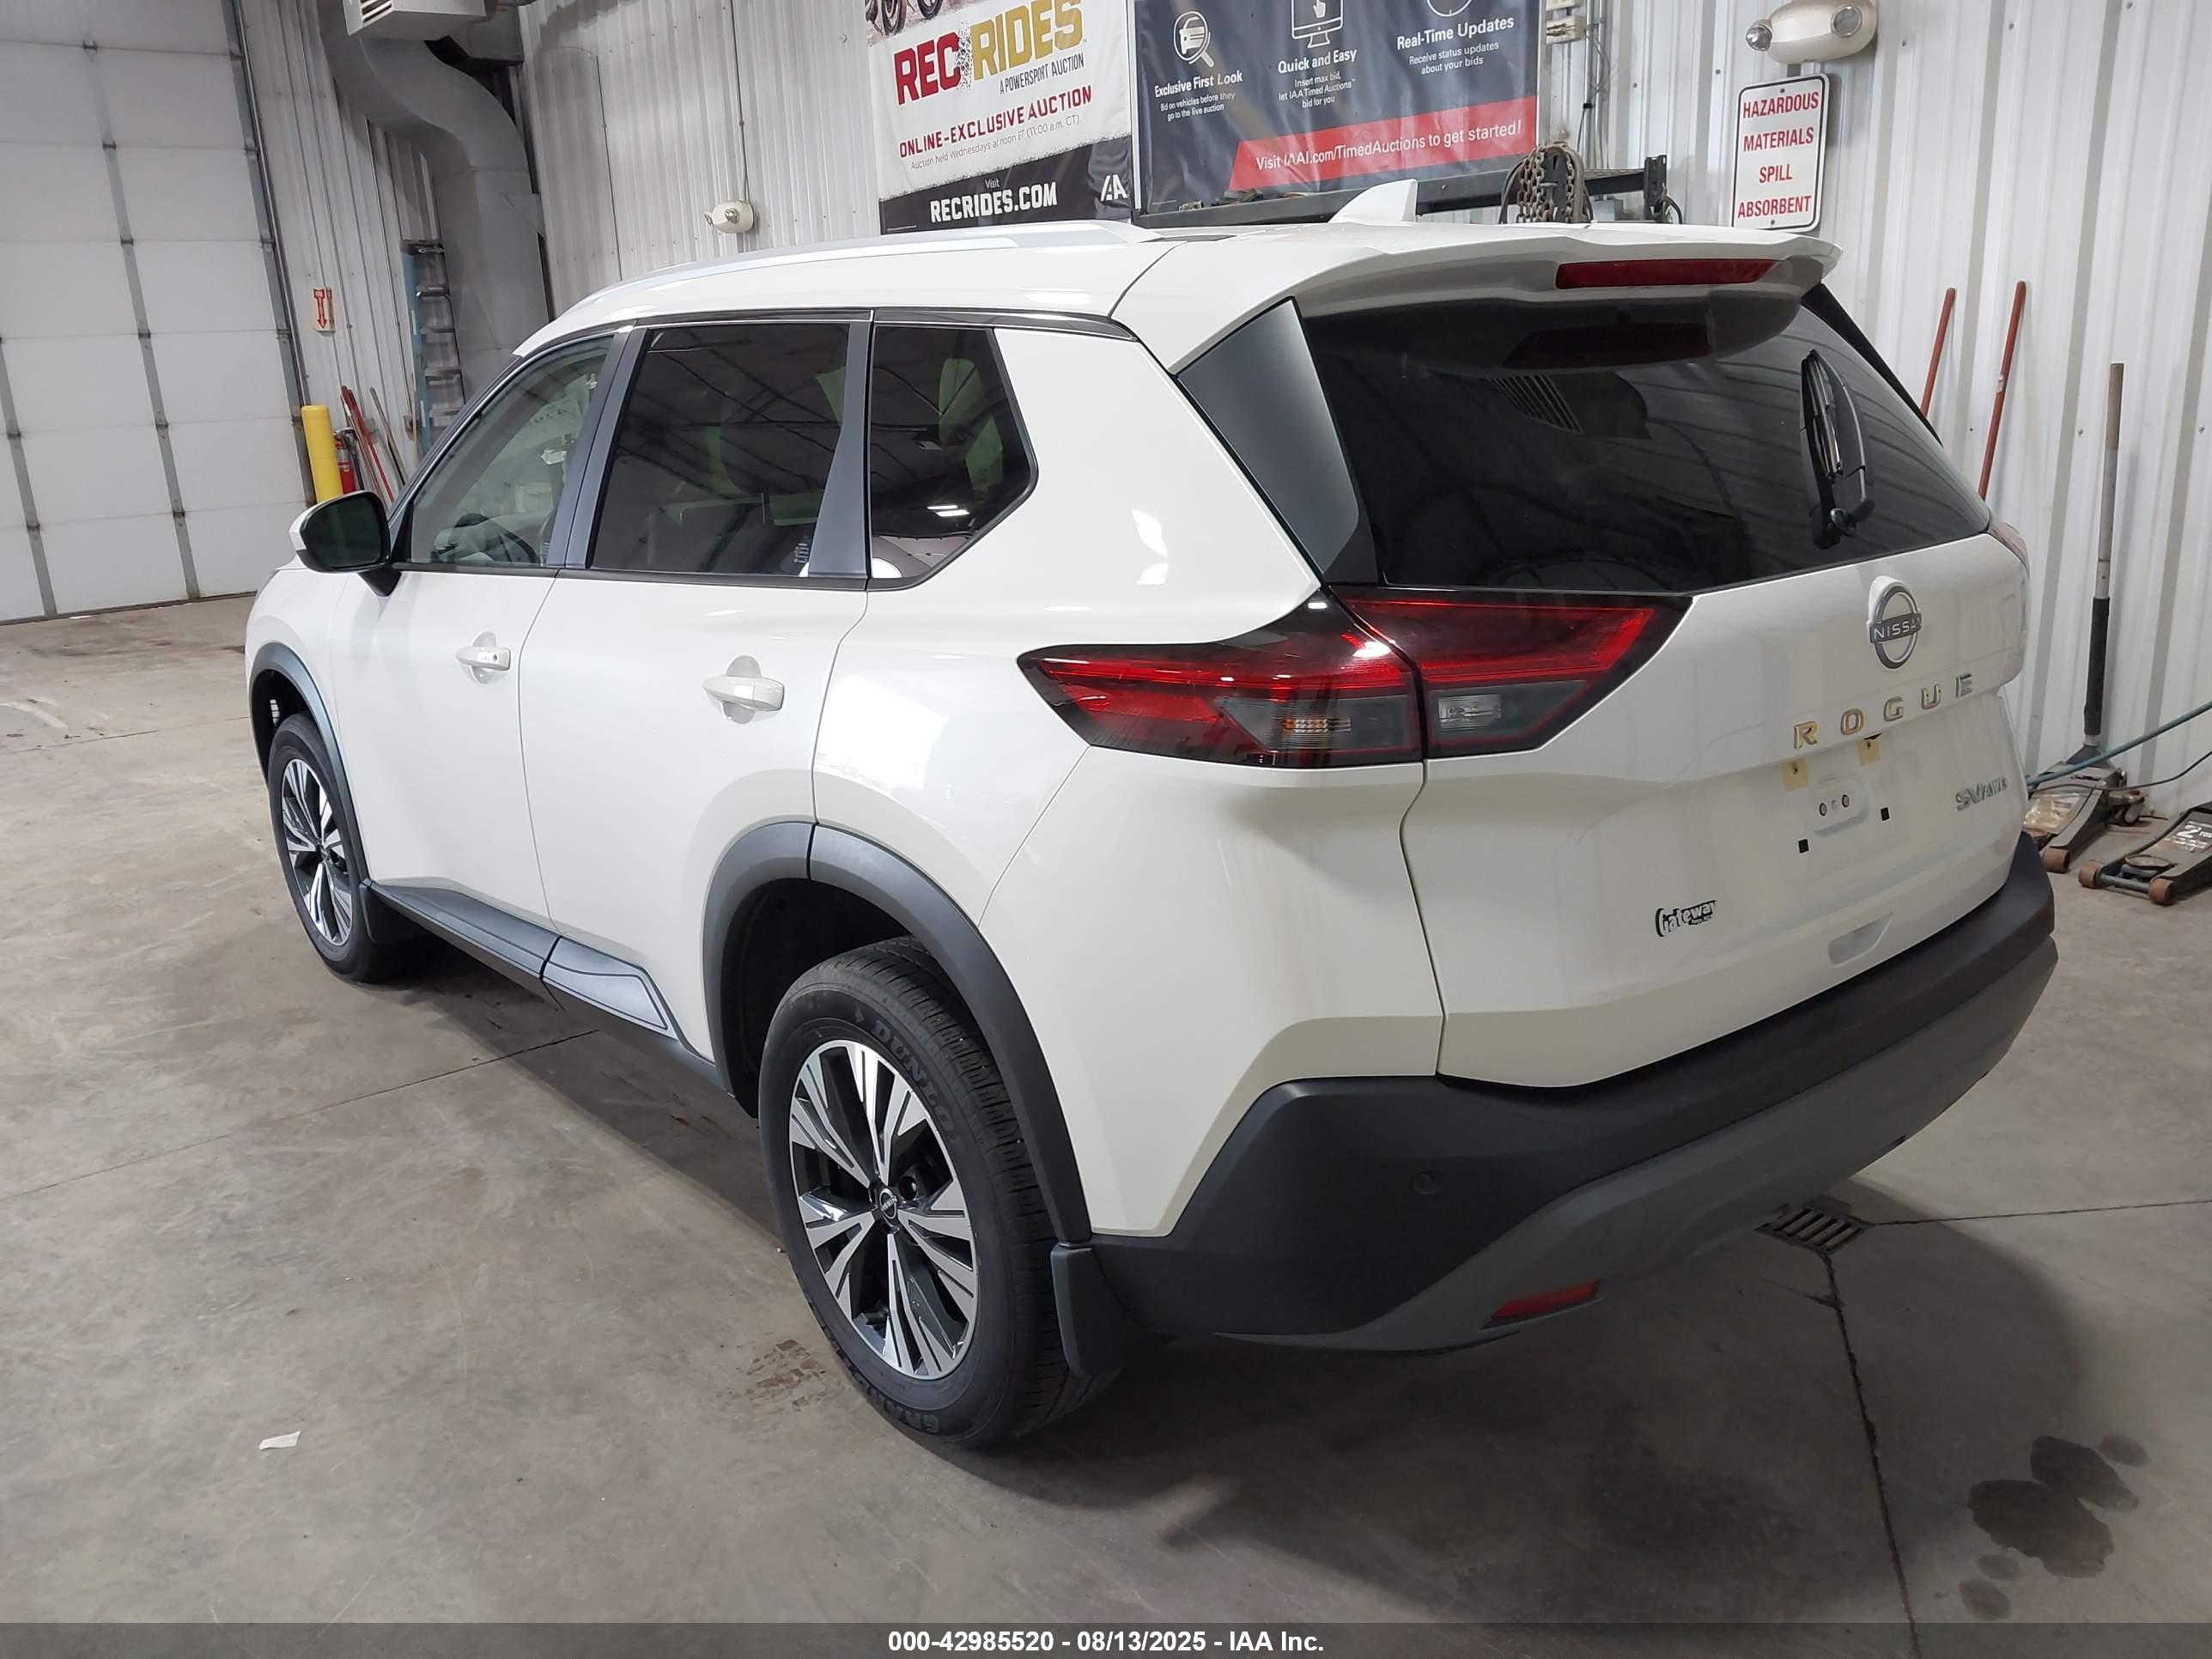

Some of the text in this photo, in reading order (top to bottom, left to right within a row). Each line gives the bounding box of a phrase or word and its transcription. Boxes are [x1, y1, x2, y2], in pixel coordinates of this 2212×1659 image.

[1397, 16, 1515, 50] Real-Time Updates
[894, 0, 1083, 106] REC RIDES
[1278, 49, 1357, 74] Quick and Easy
[1409, 41, 1499, 65] Receive status updates
[1421, 56, 1484, 75] about your bids
[1000, 52, 1085, 95] A POWERSPORT AUCTION
[1154, 70, 1243, 97] Exclusive First Look
[1294, 77, 1313, 88] Insert
[1330, 70, 1341, 80] bid,
[1176, 98, 1200, 108] vehicles
[1200, 93, 1218, 104] before
[1219, 92, 1236, 100] they
[1279, 92, 1288, 101] let
[1289, 90, 1304, 100] IAA
[1304, 86, 1323, 97] Timed
[1302, 95, 1335, 108] bid for you
[1743, 91, 1819, 118] HAZARDOUS
[899, 85, 1091, 158] ONLINE-EXCLUSIVE AUCTION
[1167, 113, 1175, 122] go
[1182, 108, 1191, 117] the
[1191, 106, 1202, 116] live
[1204, 104, 1224, 113] auction
[910, 157, 934, 171] Auction
[935, 151, 949, 164] held
[949, 142, 991, 159] Wednesdays
[993, 140, 1000, 149] at
[1000, 135, 1017, 145] noon
[1018, 130, 1024, 141] ET
[1256, 118, 1522, 170] Visit IAAI.com/TimedAuctions to get started!
[1743, 126, 1814, 152] MATERIALS
[985, 178, 1000, 189] Visit
[1759, 164, 1793, 184] SPILL
[930, 182, 1058, 223] RECRIDES.COM
[1738, 195, 1812, 219] ABSORBENT
[1794, 672, 1972, 750] ROGUE
